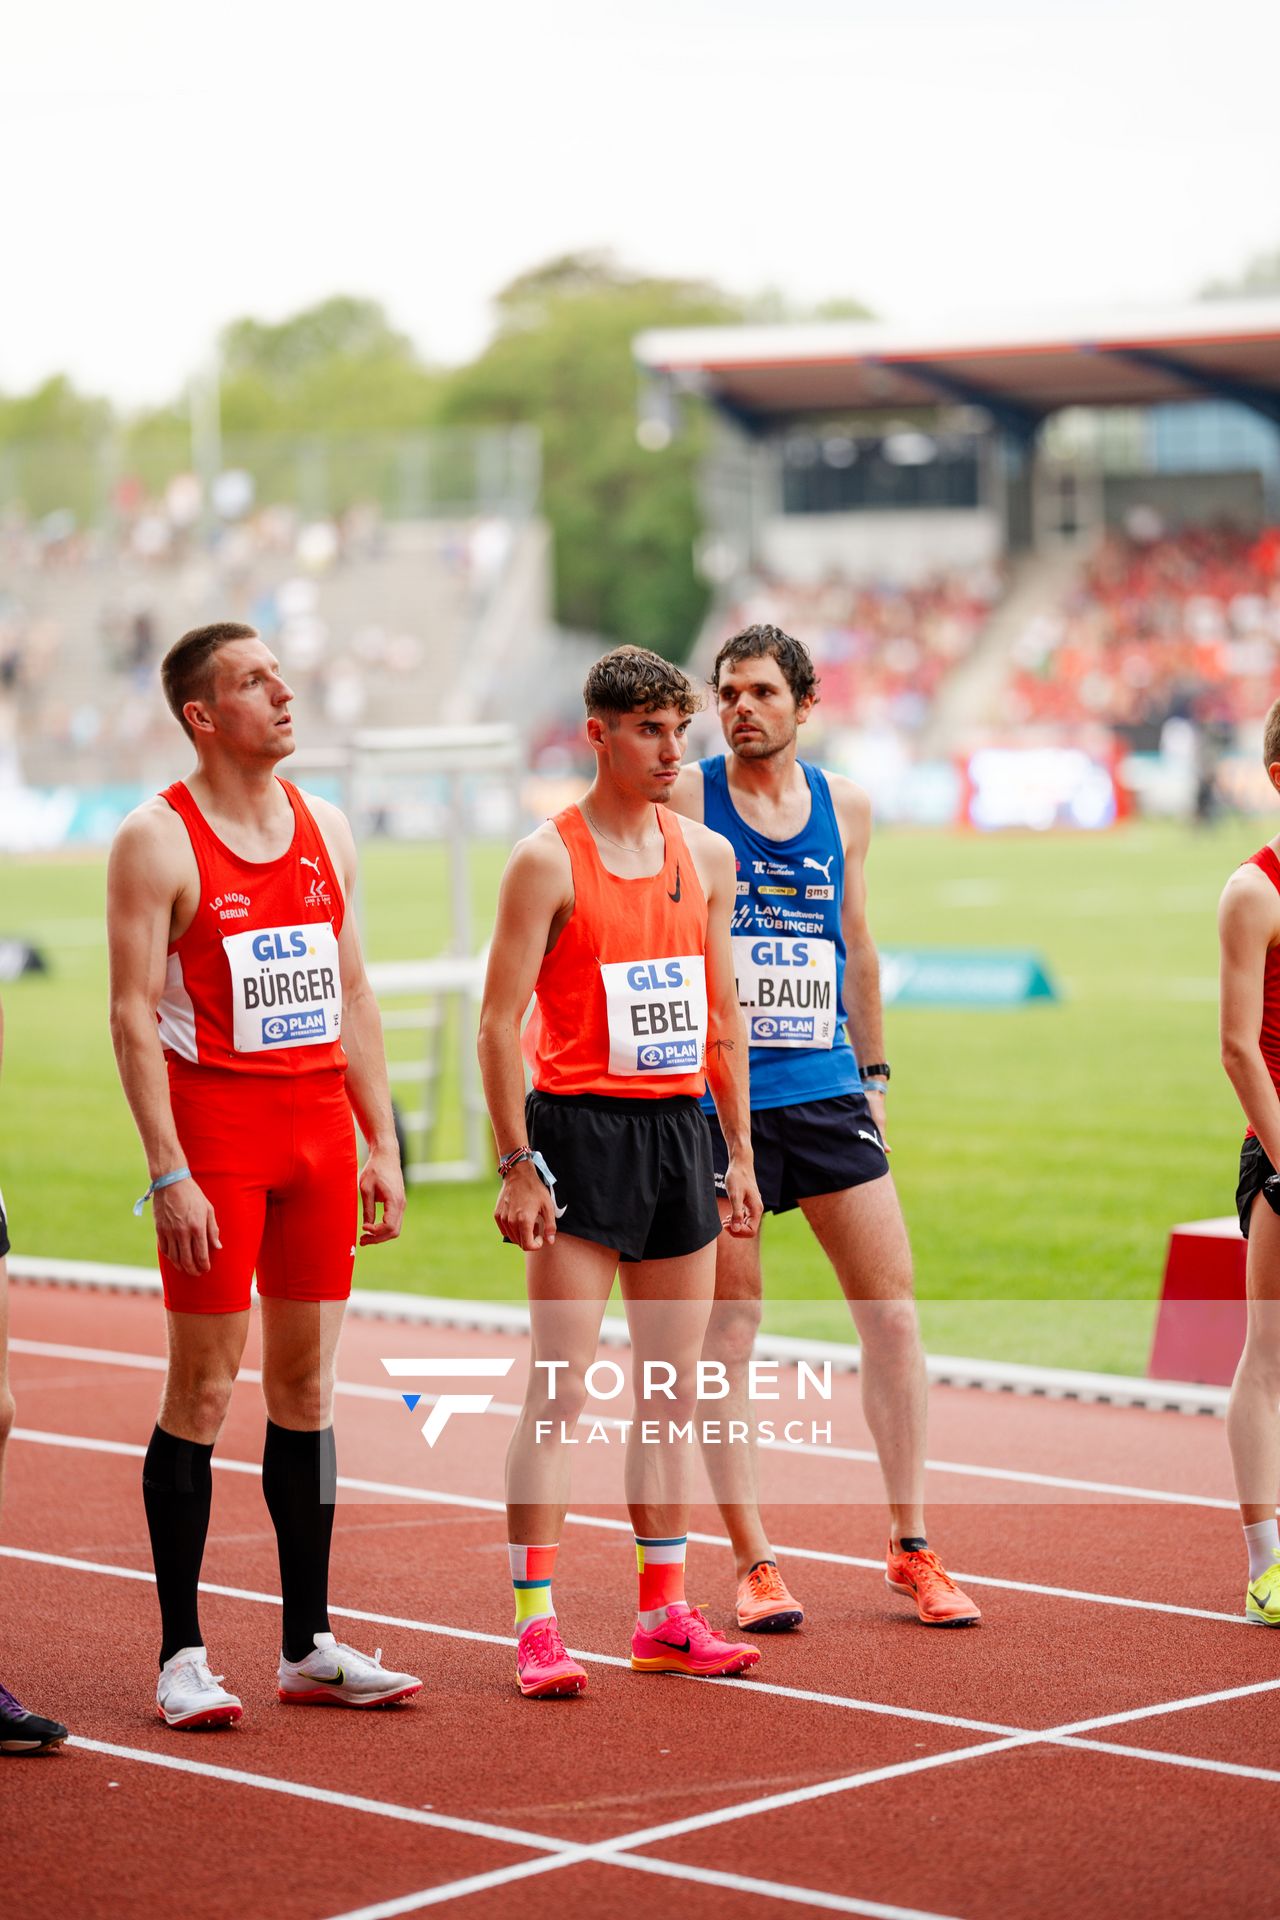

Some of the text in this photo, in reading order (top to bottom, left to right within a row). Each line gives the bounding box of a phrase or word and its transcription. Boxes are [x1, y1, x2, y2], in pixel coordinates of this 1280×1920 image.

[224, 892, 251, 906] NORD
[807, 888, 829, 899] gmg
[220, 907, 249, 920] BERLIN
[754, 904, 825, 920] LAV Stadtwerke
[756, 916, 824, 934] TÜBINGEN
[243, 967, 336, 1010] BÜRGER
[289, 1014, 324, 1031] PLAN
[630, 1000, 699, 1037] EBEL
[780, 1020, 813, 1033] PLAN
[665, 1044, 696, 1058] PLAN
